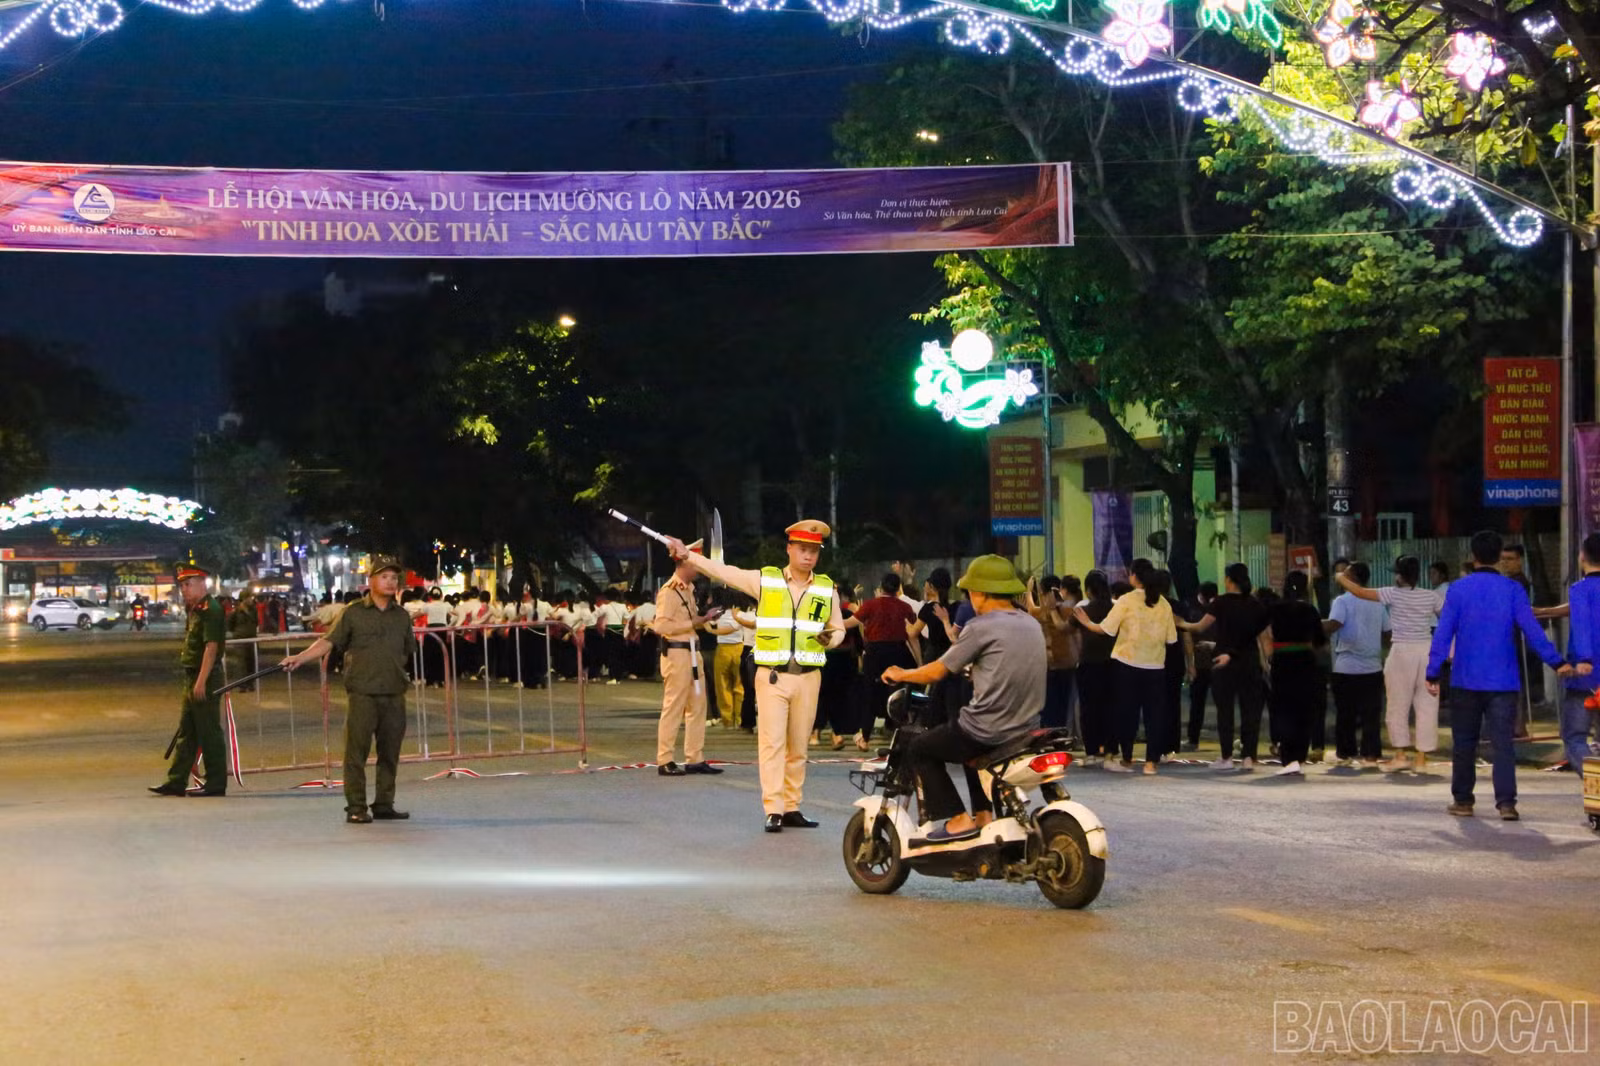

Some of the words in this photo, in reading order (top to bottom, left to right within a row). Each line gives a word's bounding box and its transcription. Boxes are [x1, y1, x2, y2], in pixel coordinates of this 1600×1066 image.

[208, 181, 239, 209] LỄ
[246, 185, 293, 214] HỘI
[300, 186, 353, 210] VĂN
[361, 187, 425, 213] HÓA,
[430, 191, 466, 211] DU
[473, 191, 531, 216] LỊCH
[538, 188, 633, 212] MƯỜNG
[640, 187, 672, 211] LÒ
[679, 187, 735, 211] NĂM
[741, 190, 801, 209] 2026
[837, 210, 853, 220] Văn
[893, 209, 912, 219] thao
[913, 209, 924, 218] và
[925, 208, 938, 218] Du
[976, 206, 992, 216] Lào
[993, 205, 1008, 215] Cai
[29, 224, 51, 233] BAN
[53, 223, 83, 233] NHÂN
[85, 224, 108, 234] DÂN
[159, 228, 177, 236] CAI
[325, 221, 382, 241] HOA
[388, 218, 440, 242] XÒE
[446, 219, 509, 242] THÁI
[540, 215, 590, 242] SẮC
[596, 218, 652, 241] MÀU
[658, 217, 705, 241] TÂY
[1487, 486, 1559, 500] vinaphone
[1333, 500, 1349, 512] 43
